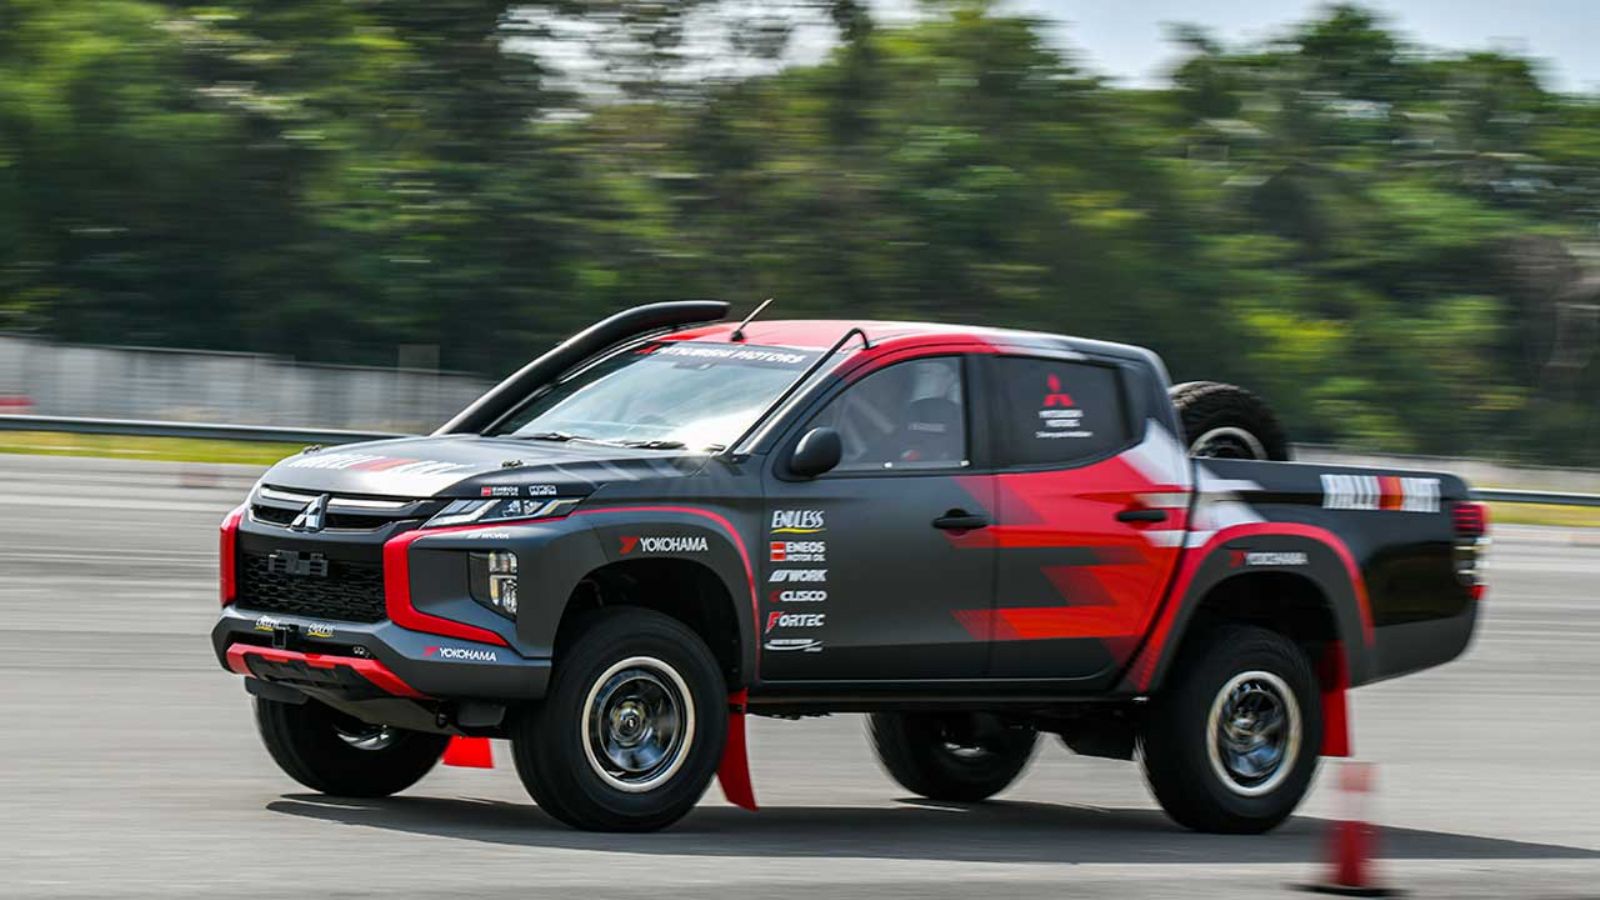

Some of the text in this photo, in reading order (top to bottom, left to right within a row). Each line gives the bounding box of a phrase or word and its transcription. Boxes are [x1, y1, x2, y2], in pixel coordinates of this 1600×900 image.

[640, 537, 709, 552] YOKOHAMA
[786, 541, 826, 553] ENEOS
[787, 569, 828, 582] WORK
[780, 590, 828, 602] CUSCO
[765, 610, 826, 634] FORTEC
[439, 647, 497, 662] YOKOHAMA
